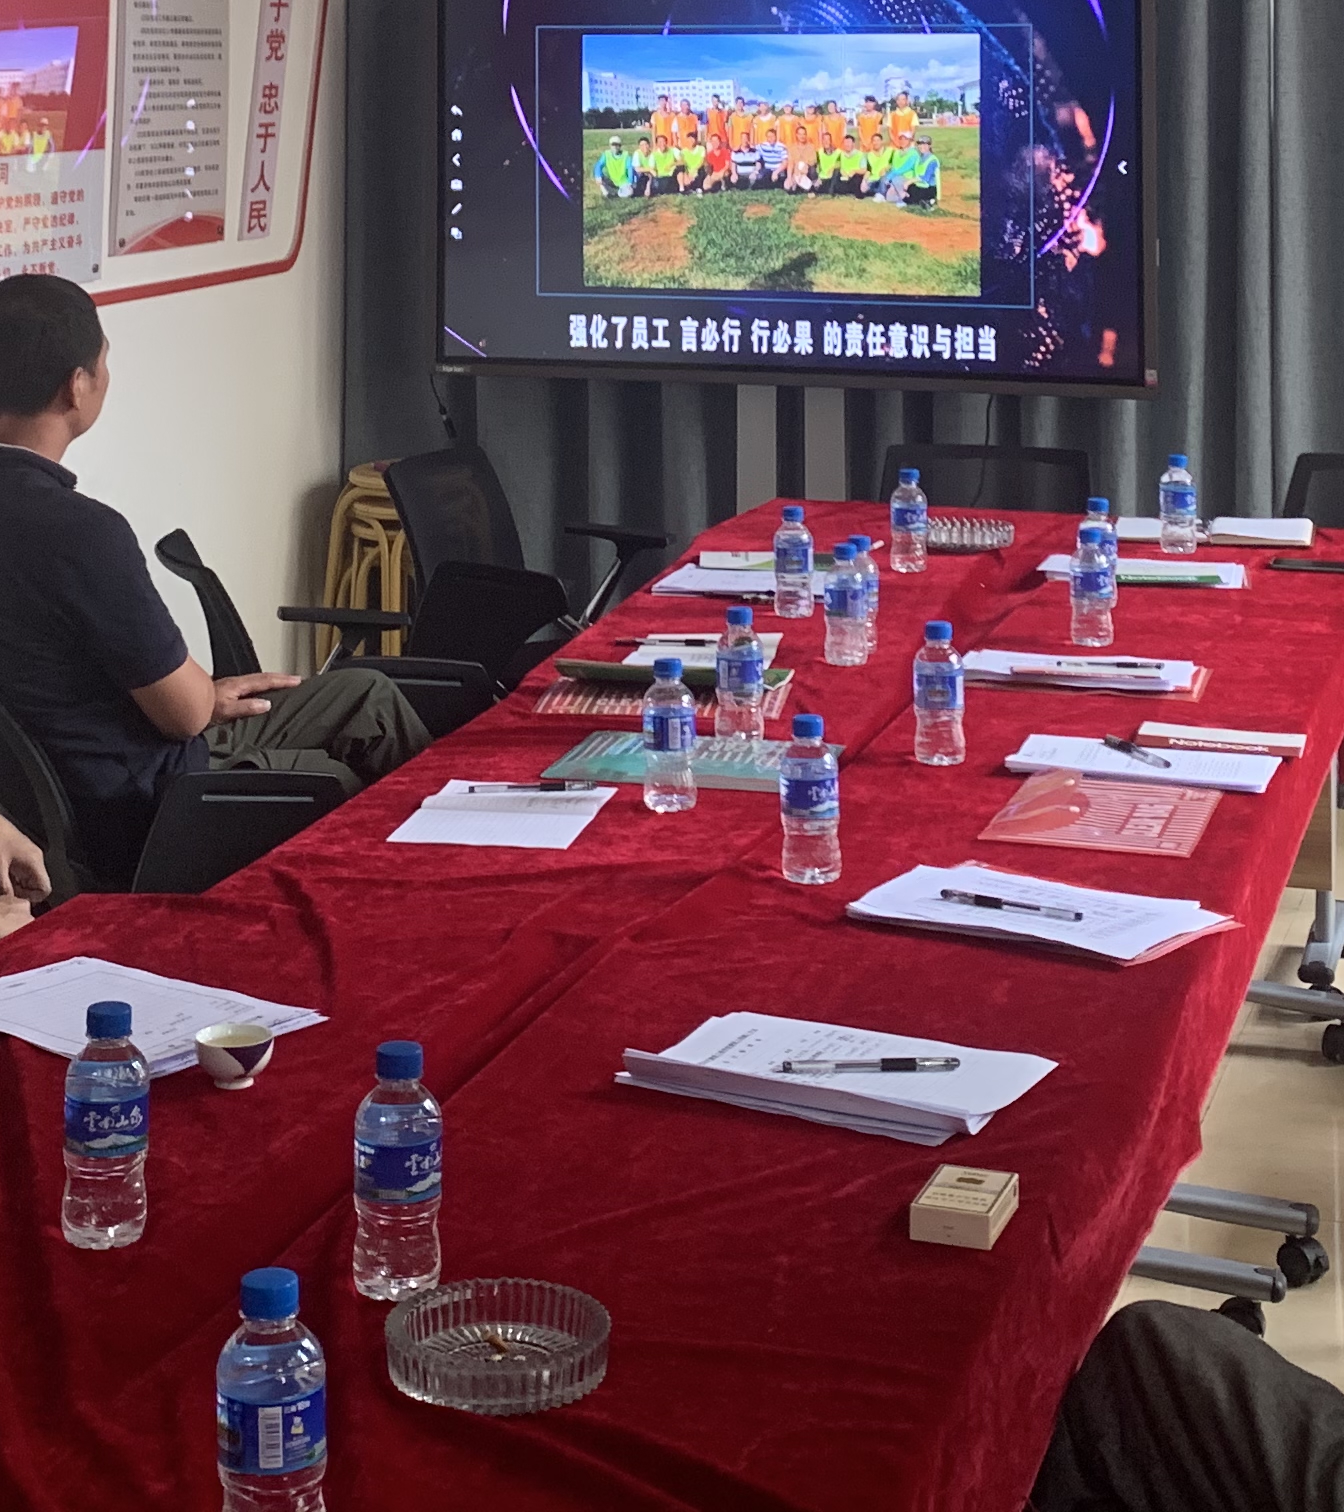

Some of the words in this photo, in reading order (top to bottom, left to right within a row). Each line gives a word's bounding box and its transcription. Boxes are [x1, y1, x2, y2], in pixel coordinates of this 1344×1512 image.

[246, 81, 279, 235] 忠于人民
[568, 314, 670, 350] 强化了员工
[680, 317, 742, 353] 言必行
[750, 318, 813, 355] 行必果
[823, 320, 997, 362] 的责任意识与担当
[1168, 738, 1269, 753] Notebook
